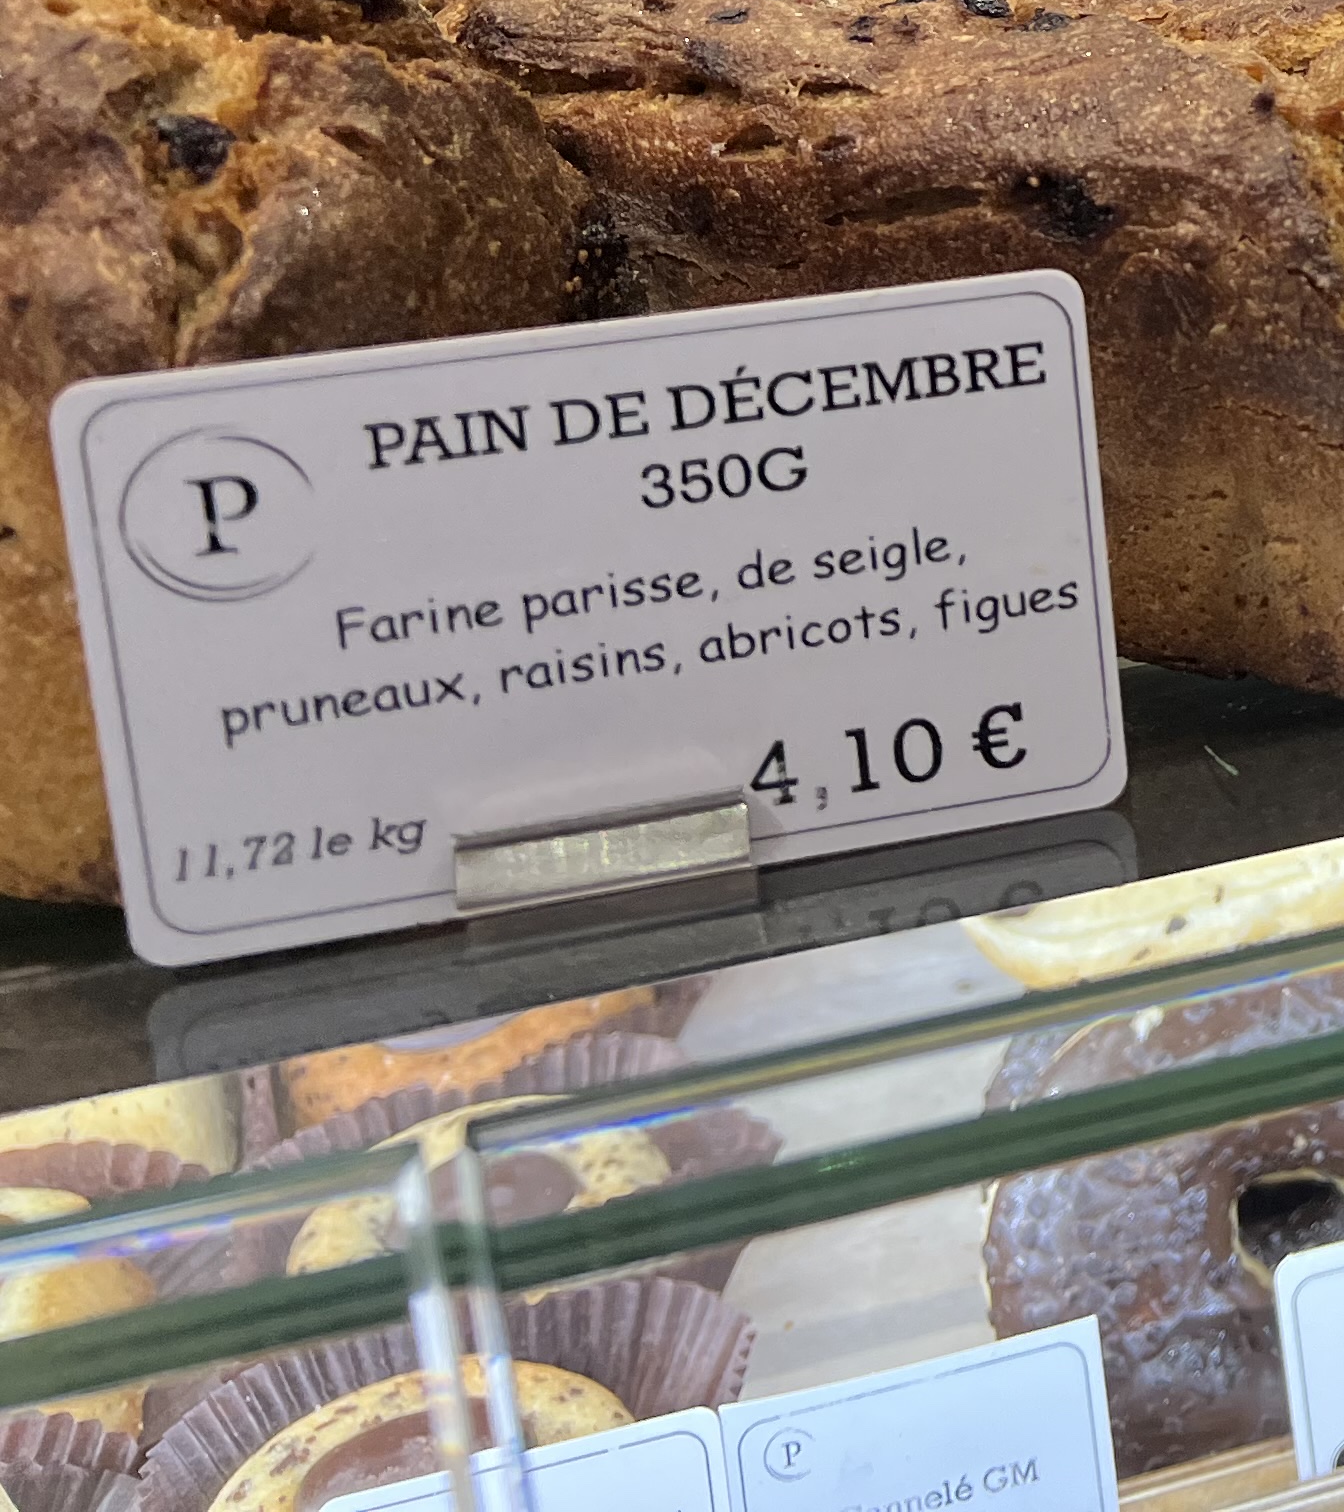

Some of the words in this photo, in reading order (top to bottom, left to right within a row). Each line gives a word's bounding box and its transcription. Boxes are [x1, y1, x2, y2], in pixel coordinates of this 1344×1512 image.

[364, 404, 529, 469] PAIN
[552, 389, 650, 447] DE
[670, 341, 1048, 432] DÉCEMBRE
[187, 474, 259, 557] P
[641, 445, 808, 509] 350G
[334, 598, 505, 651] Farine
[520, 569, 720, 633] parisse,
[736, 551, 797, 592] de
[812, 526, 968, 583] seigle,
[221, 671, 482, 750] pruneaux,
[499, 638, 684, 695] raisins,
[698, 600, 918, 667] abricots,
[935, 579, 1080, 640] figues
[750, 717, 943, 811] 4,10
[971, 701, 1028, 769] €
[176, 830, 296, 881] 11,72
[310, 825, 353, 860] le
[368, 816, 427, 855] kg
[780, 1440, 802, 1469] P
[982, 1455, 1041, 1494] GM
